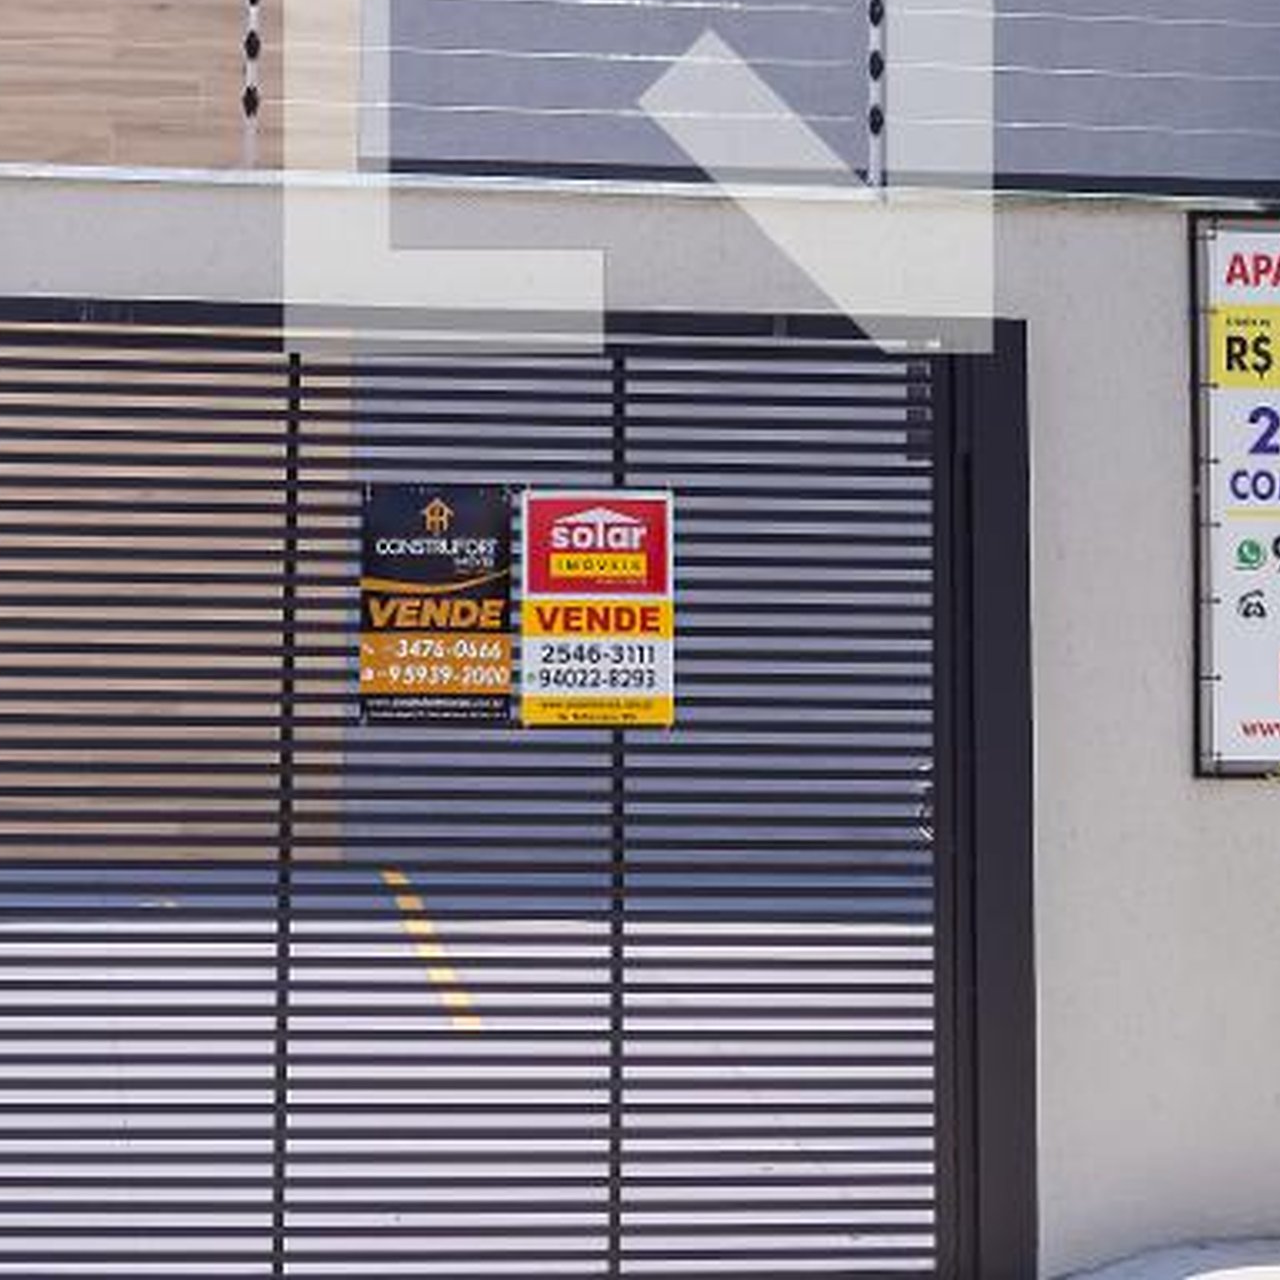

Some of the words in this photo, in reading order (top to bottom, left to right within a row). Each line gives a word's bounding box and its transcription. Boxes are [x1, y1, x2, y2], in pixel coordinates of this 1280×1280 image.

[1225, 332, 1273, 380] R$
[1248, 406, 1280, 455] 2
[550, 521, 647, 549] solar
[369, 598, 505, 628] VENDE
[536, 606, 660, 633] VENDE
[541, 644, 656, 664] 2546-3111
